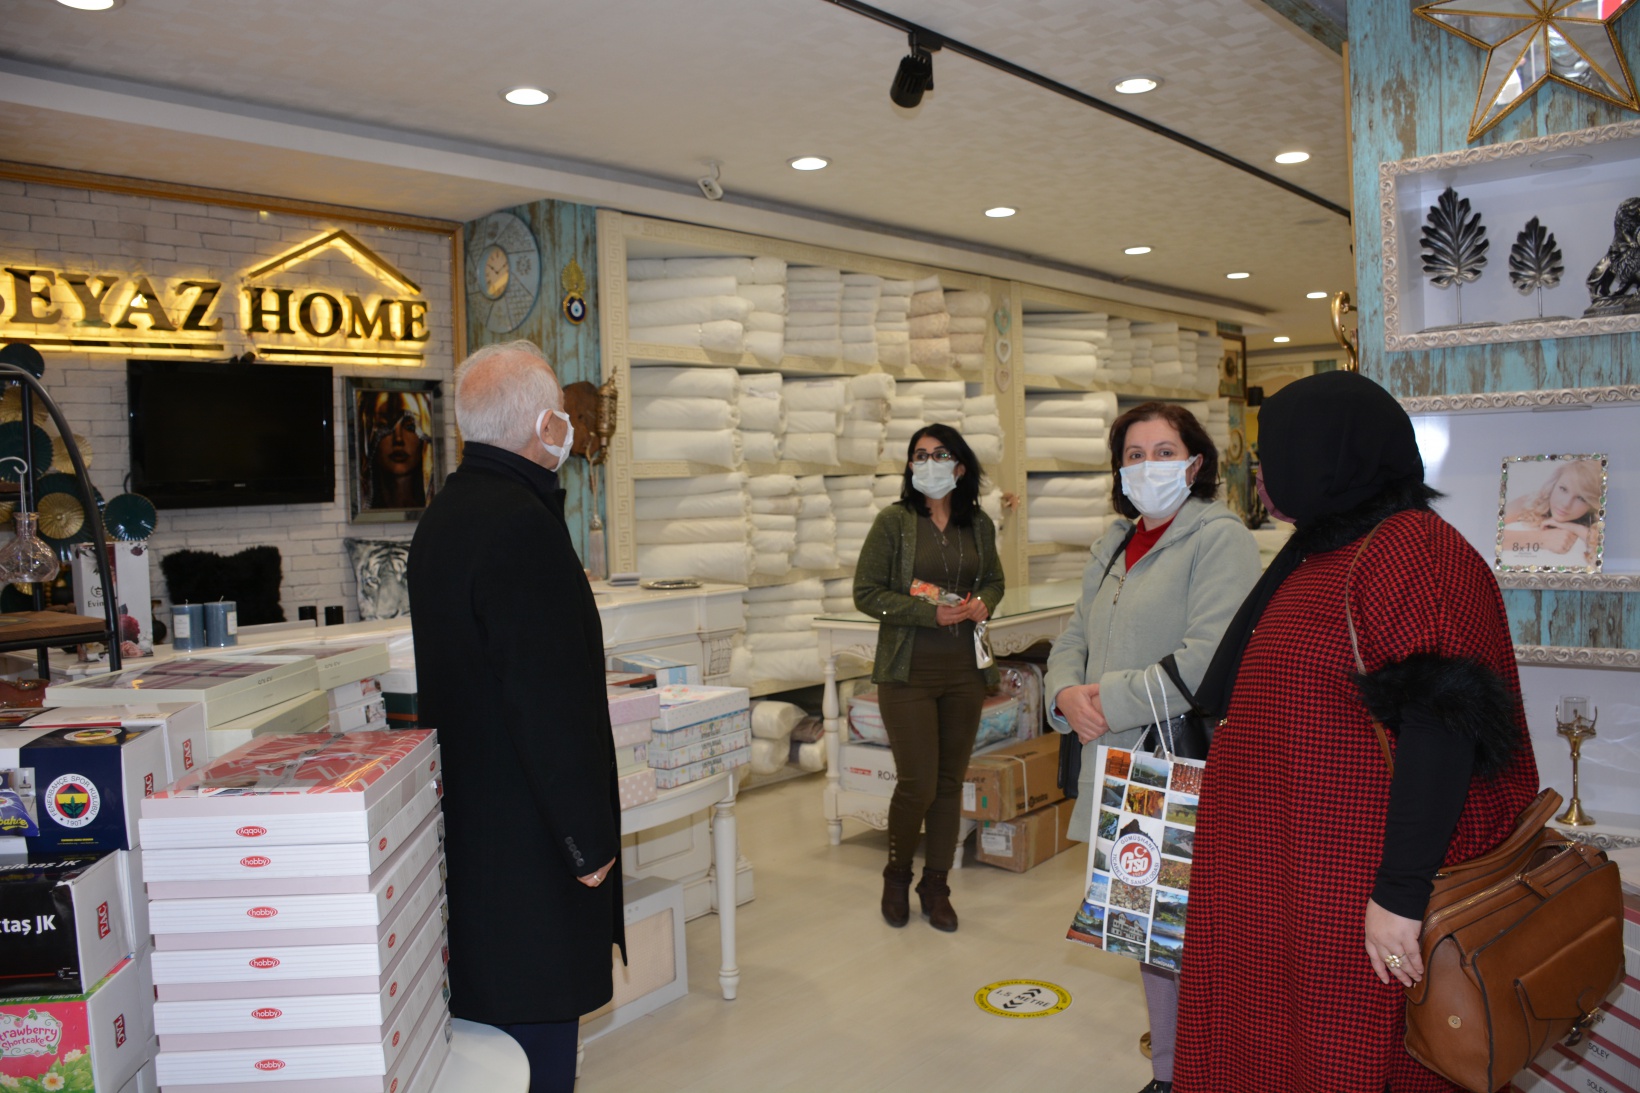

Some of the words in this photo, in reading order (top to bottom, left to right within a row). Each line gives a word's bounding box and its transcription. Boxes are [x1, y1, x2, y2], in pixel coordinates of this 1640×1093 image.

[0, 266, 223, 333] EYAZ
[241, 285, 431, 342] HOME
[46, 776, 68, 817] FENERBAHÇE
[71, 775, 90, 788] SPOR
[66, 819, 82, 827] 1907
[240, 827, 263, 836] hobby
[243, 856, 267, 866] hobby
[250, 906, 274, 917] hobby
[35, 914, 56, 935] JK
[253, 958, 277, 968] hobby
[1014, 995, 1050, 1008] METRE
[255, 1008, 279, 1019] hobby
[1, 1034, 46, 1051] Shortcake
[1588, 1042, 1610, 1060] SOLEY
[258, 1059, 282, 1070] hobby
